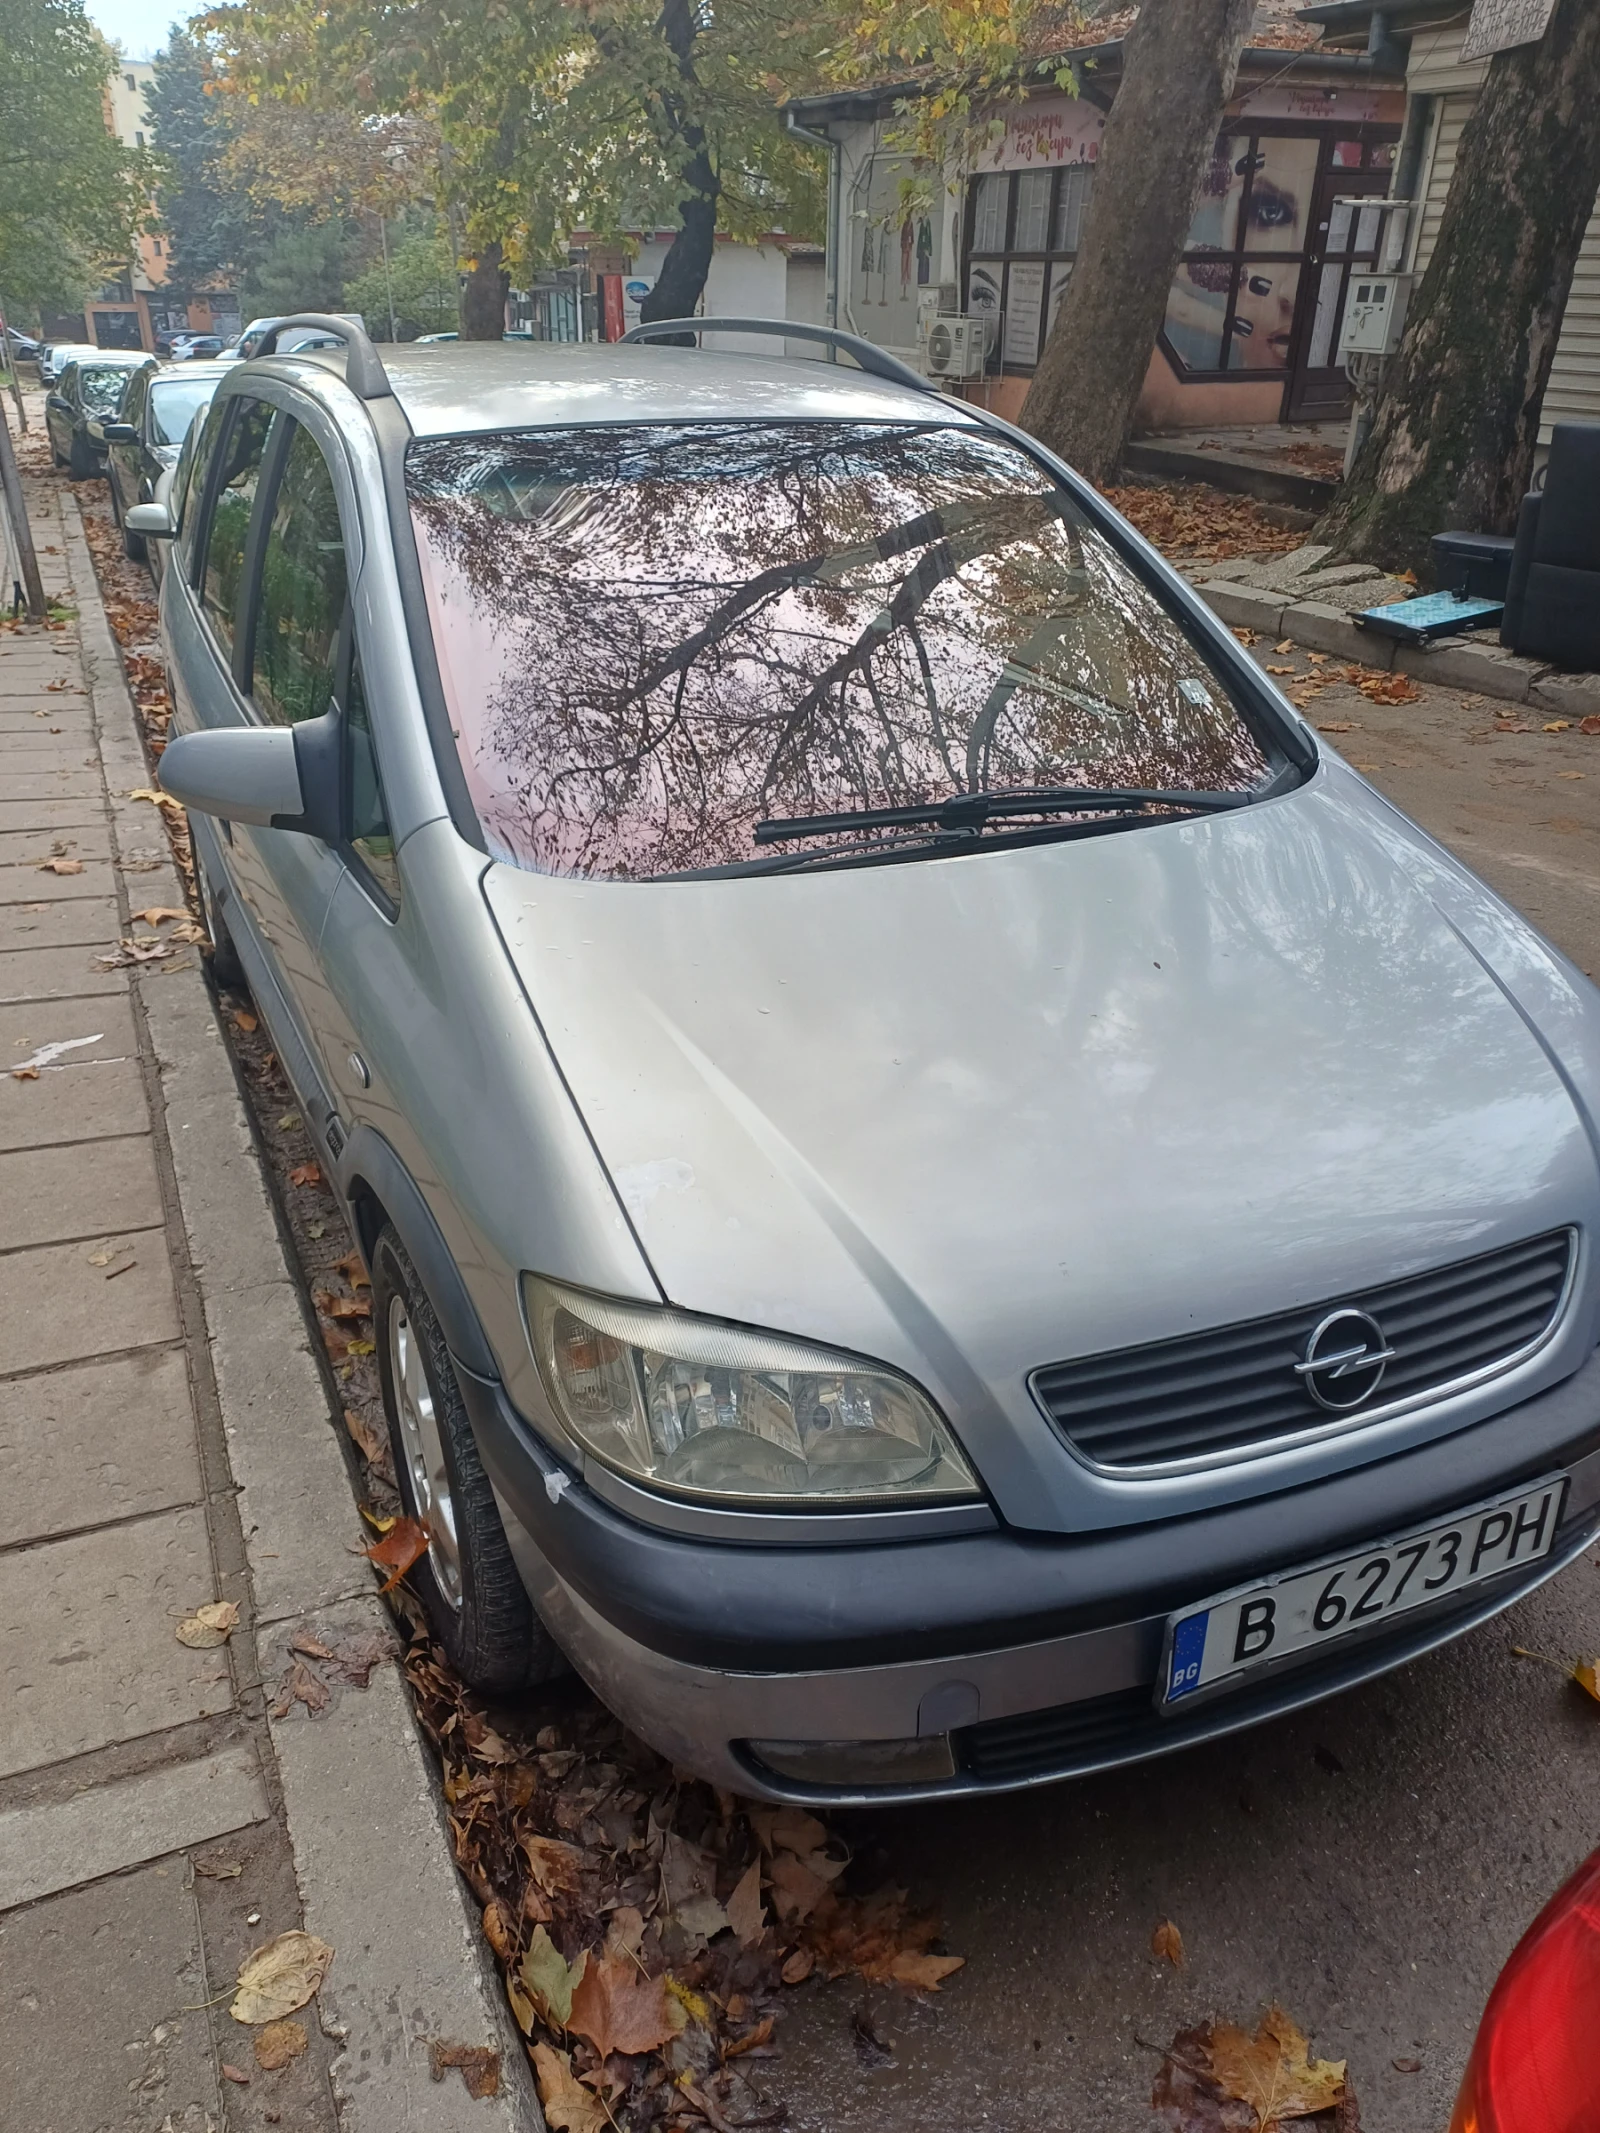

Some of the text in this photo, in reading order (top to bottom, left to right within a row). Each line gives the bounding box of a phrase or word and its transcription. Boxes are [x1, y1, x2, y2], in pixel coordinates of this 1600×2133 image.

[1233, 1492, 1553, 1664] B 6273 PH
[1172, 1662, 1198, 1689] BG
